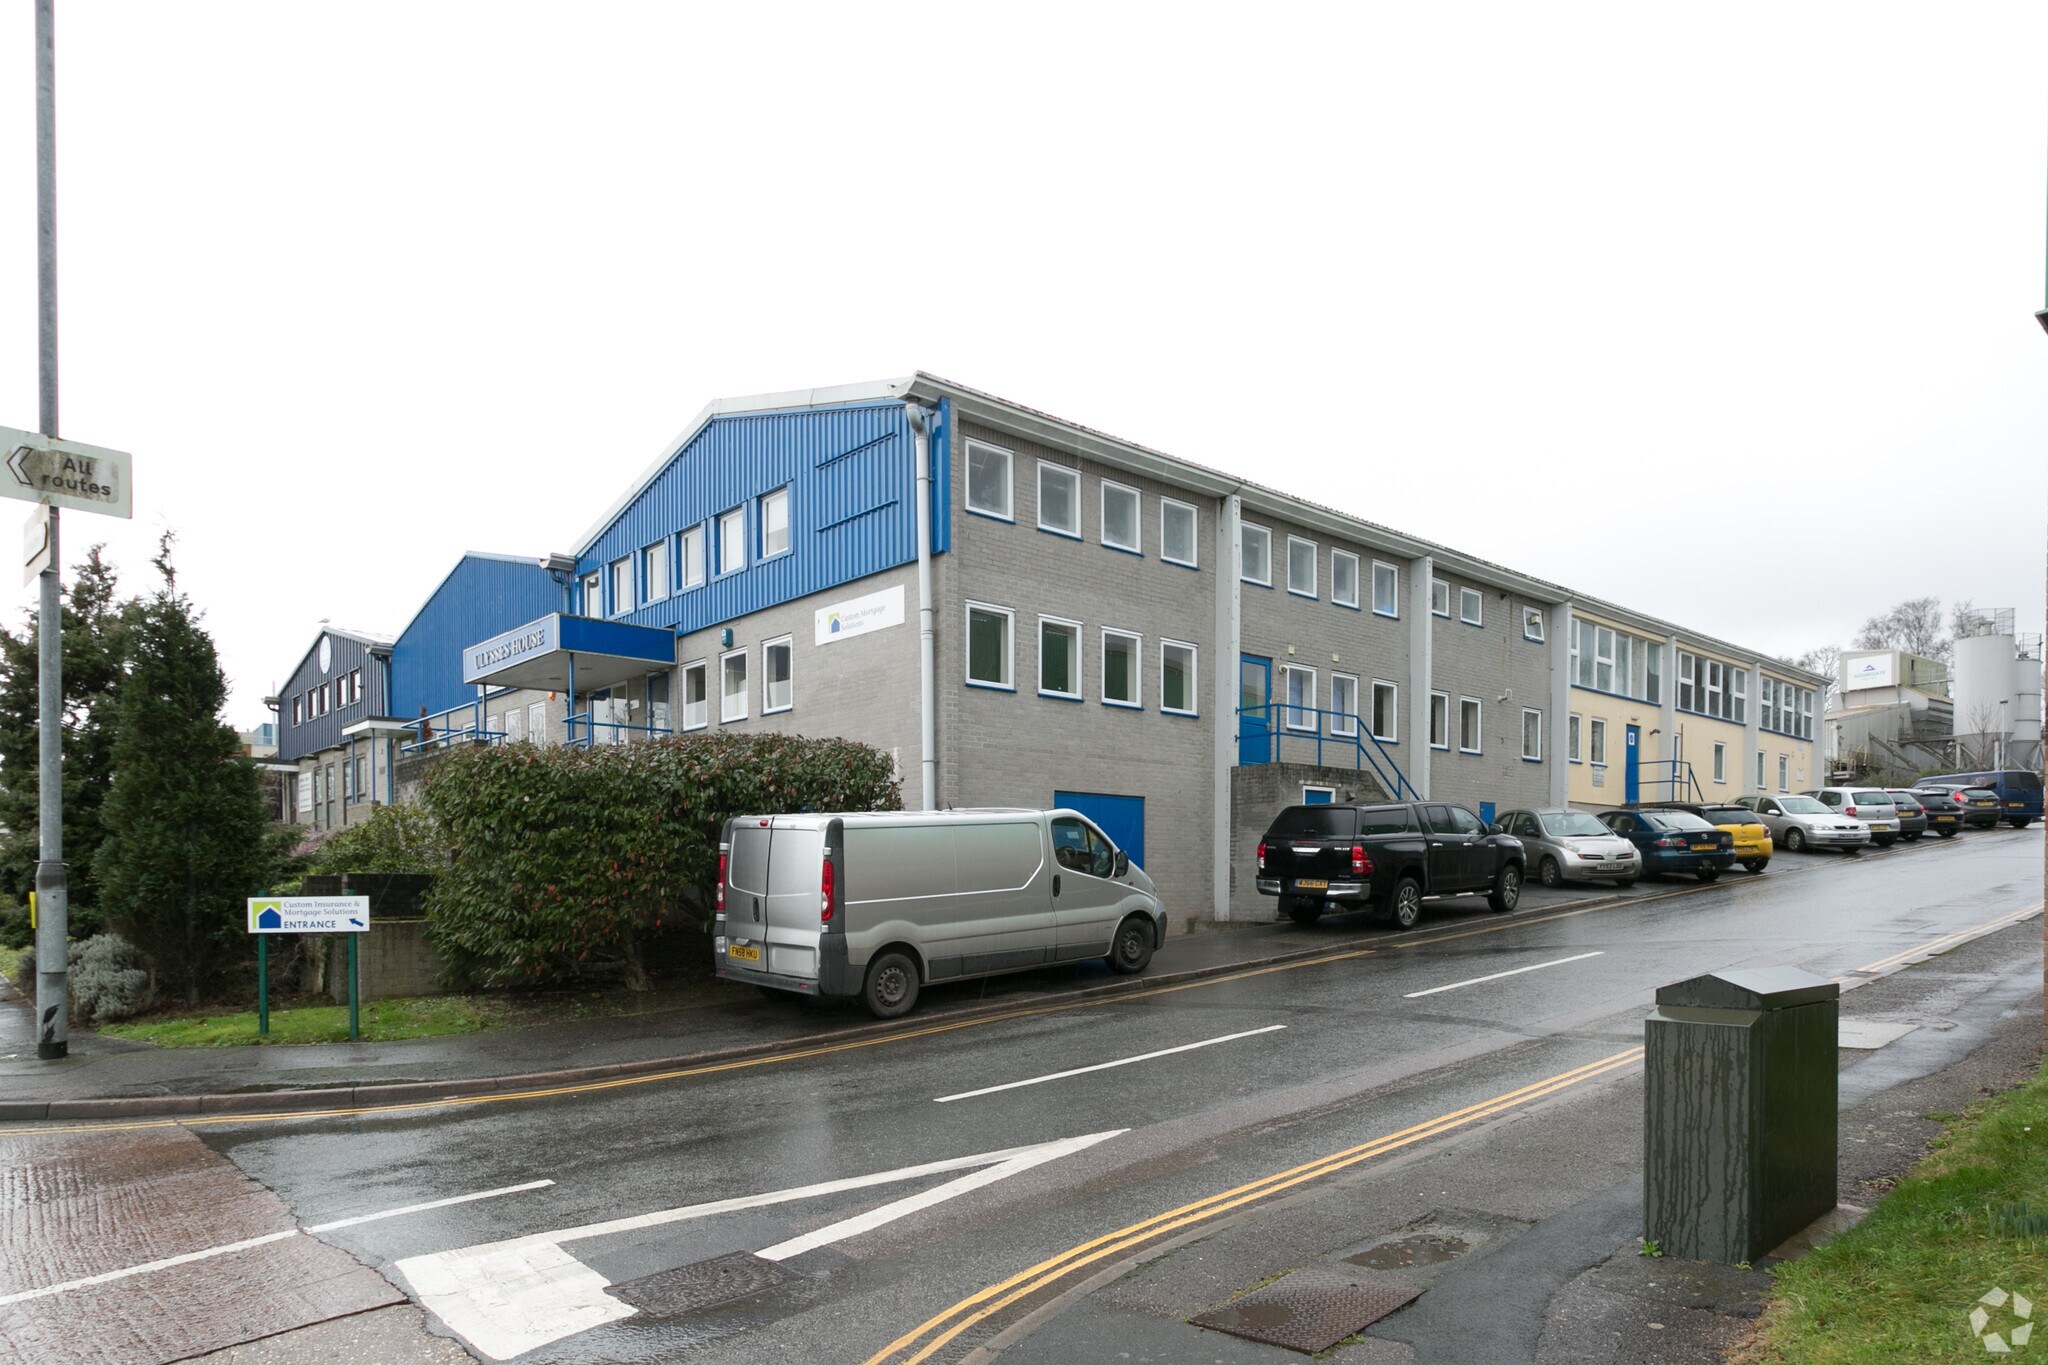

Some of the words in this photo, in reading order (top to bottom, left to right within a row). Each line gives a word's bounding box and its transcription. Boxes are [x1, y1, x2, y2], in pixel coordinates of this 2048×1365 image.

[63, 458, 92, 476] All
[42, 475, 111, 496] routes
[841, 612, 860, 623] Custom
[860, 605, 886, 617] Mortgage
[841, 620, 864, 632] Solutions
[474, 643, 511, 669] ULYSSES
[512, 629, 545, 656] HOUSE
[284, 901, 313, 909] Custom
[284, 909, 322, 917] Mortgage
[284, 920, 337, 929] ENTRANCE
